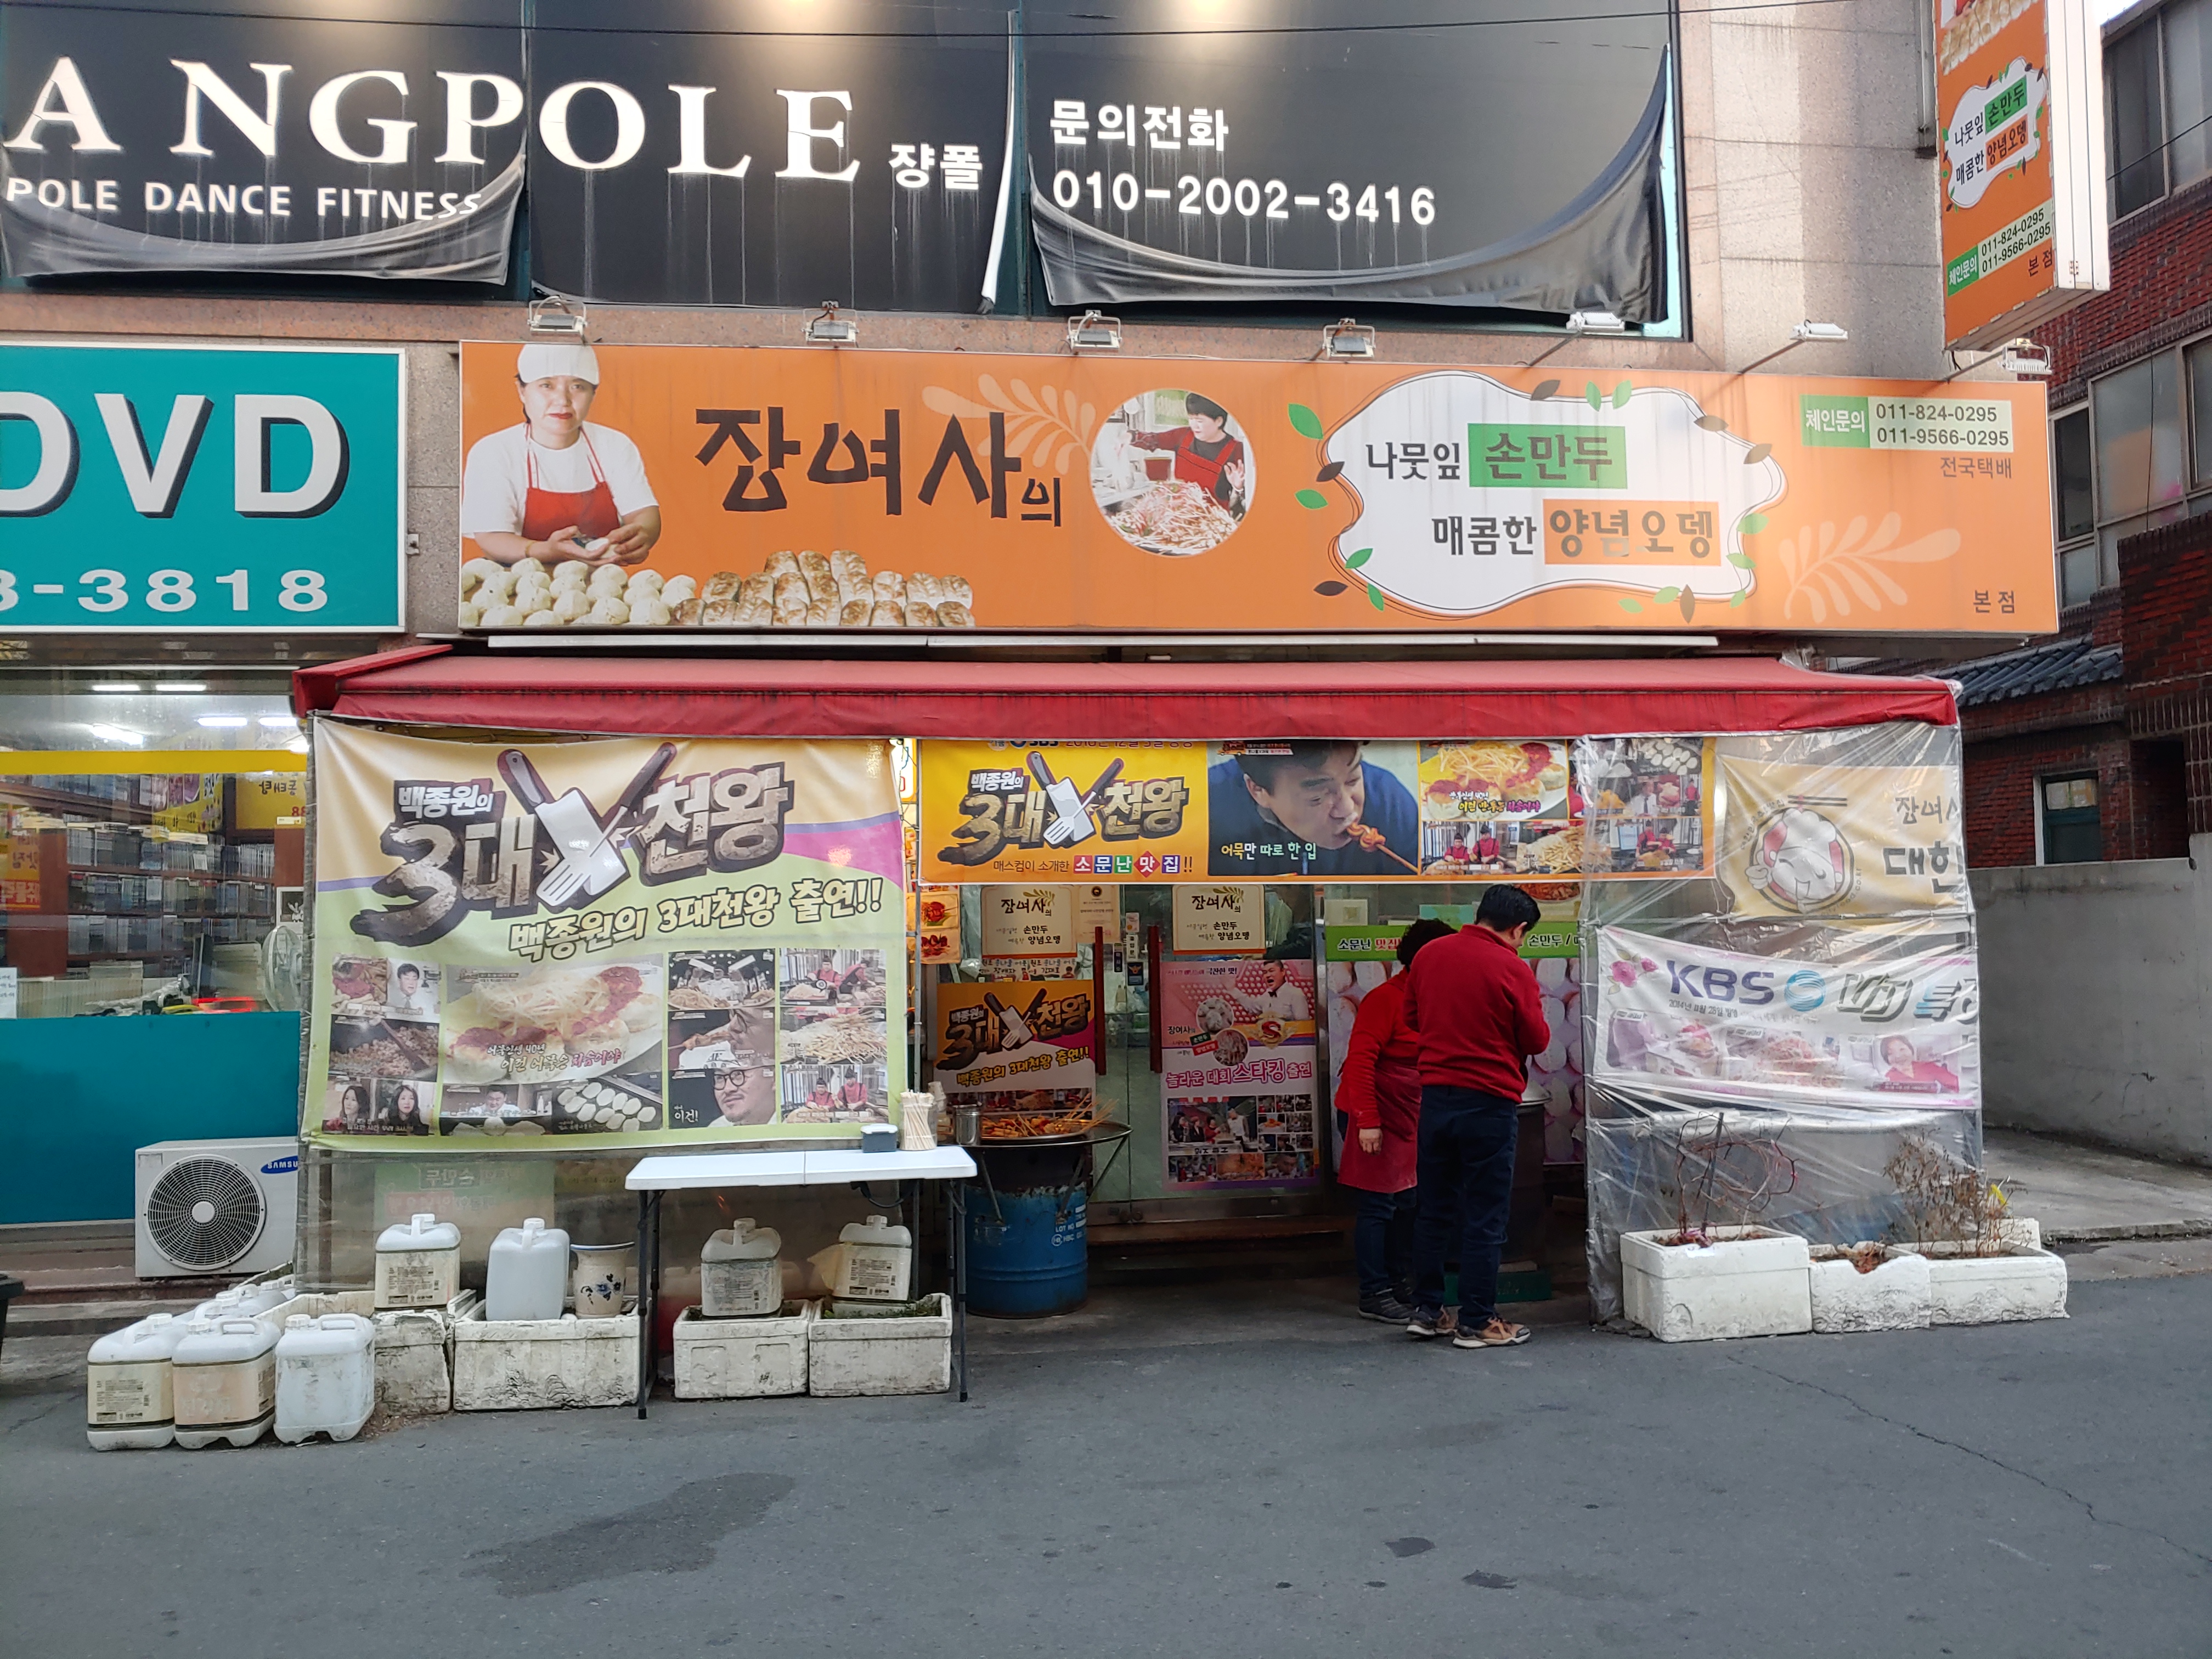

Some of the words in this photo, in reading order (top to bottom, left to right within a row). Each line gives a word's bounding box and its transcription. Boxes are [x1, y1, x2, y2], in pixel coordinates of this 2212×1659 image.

[1051, 99, 1229, 151] 문의전화
[1954, 111, 1984, 148] 나뭇잎
[1987, 81, 2025, 127] 손만두
[888, 142, 983, 190] 쟝폴
[1956, 150, 1985, 186] 매콤한
[1986, 120, 2028, 165] 양념오뎅
[7, 177, 119, 213] POLE
[145, 181, 291, 216] DANCE
[317, 186, 484, 221] FITNESS
[1053, 169, 1436, 226] 010-2002-3416
[1981, 208, 2045, 257] 011-824-0295
[1982, 222, 2051, 273] 011-9566-0295
[1805, 407, 1865, 433] 체인문의
[1876, 427, 2010, 447] 011-9566-0295
[1875, 402, 1997, 423] 011-824-0295
[0, 391, 350, 519] DVD
[1366, 442, 1461, 481] 나뭇잎
[1485, 432, 1613, 481] 손만두
[1940, 456, 2012, 479] 전국택배
[1432, 516, 1537, 556] 매콤한
[1549, 509, 1713, 558] 양념오뎅
[397, 783, 494, 819] 백종원의
[970, 771, 1024, 792] 백종원의
[993, 860, 1035, 873] 매스컴이
[1039, 860, 1070, 873] 소개한
[1221, 843, 1257, 861] 어묵만
[1260, 842, 1284, 856] 따로
[509, 907, 648, 962] 백종원의
[657, 884, 781, 933] 3대천왕
[790, 877, 883, 924] 출연!!
[1023, 925, 1048, 934] 손만두
[1212, 921, 1238, 930] 손만두
[1528, 933, 1562, 948] 손만두
[1338, 938, 1372, 952] 소문난
[1666, 960, 1775, 1006] KBS
[957, 1065, 1006, 1087] 백종원의
[1009, 1054, 1052, 1075] 3대천왕
[1166, 1071, 1204, 1089] 놀라운
[1207, 1069, 1231, 1085] 대회
[1233, 1058, 1285, 1084] 스타킹
[1287, 1061, 1312, 1080] 출연
